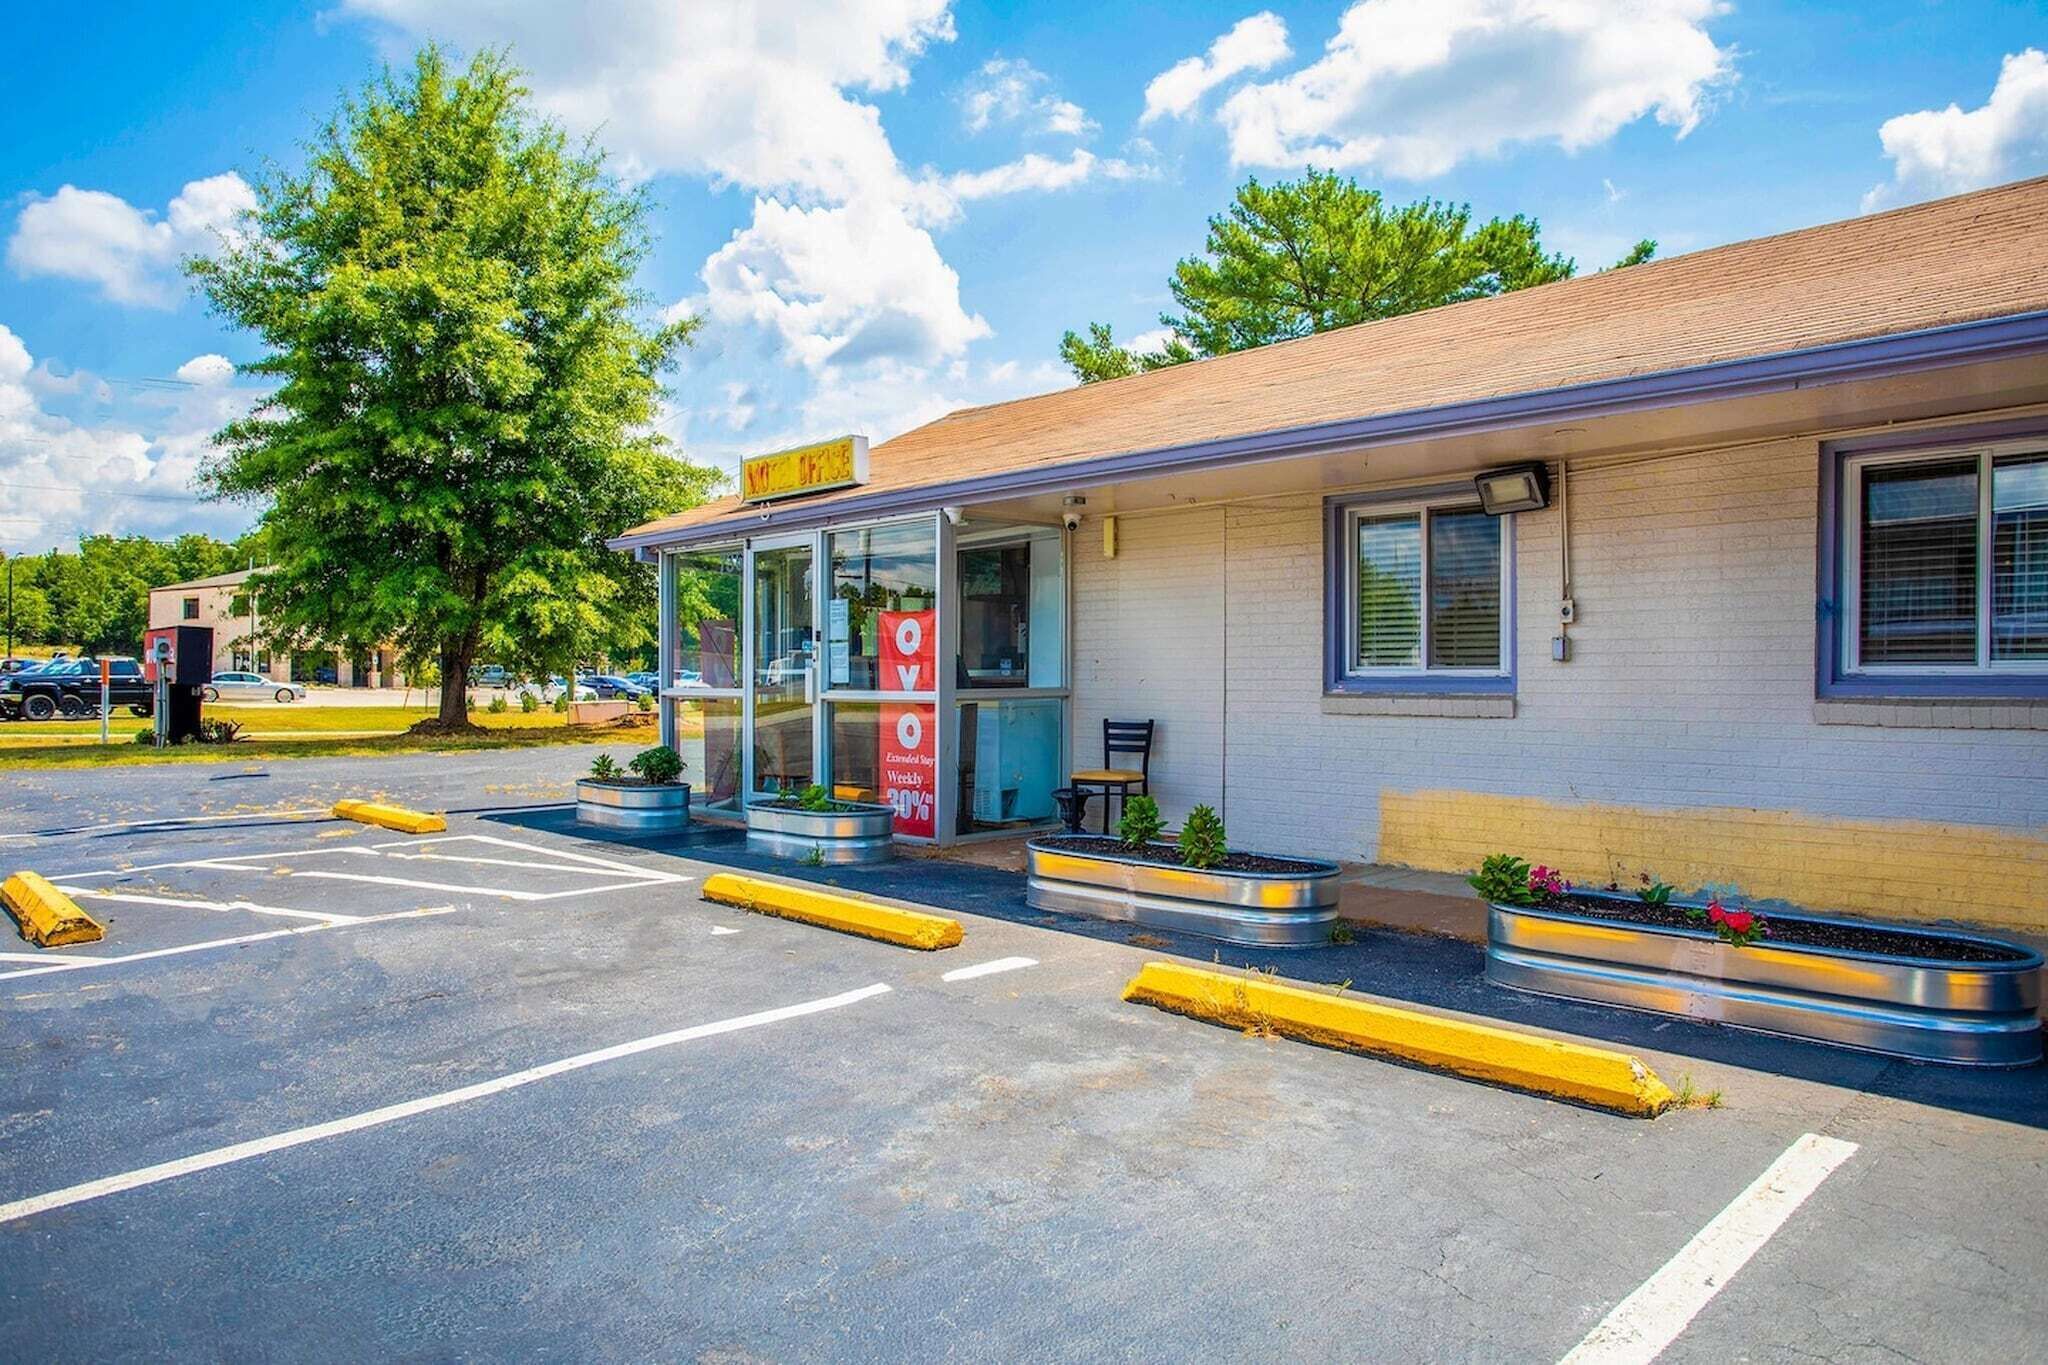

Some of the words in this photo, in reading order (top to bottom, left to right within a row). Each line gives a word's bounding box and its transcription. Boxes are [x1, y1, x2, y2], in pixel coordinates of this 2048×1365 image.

[886, 752, 919, 764] Extended
[920, 754, 934, 768] Stay
[887, 770, 923, 788] Weekly
